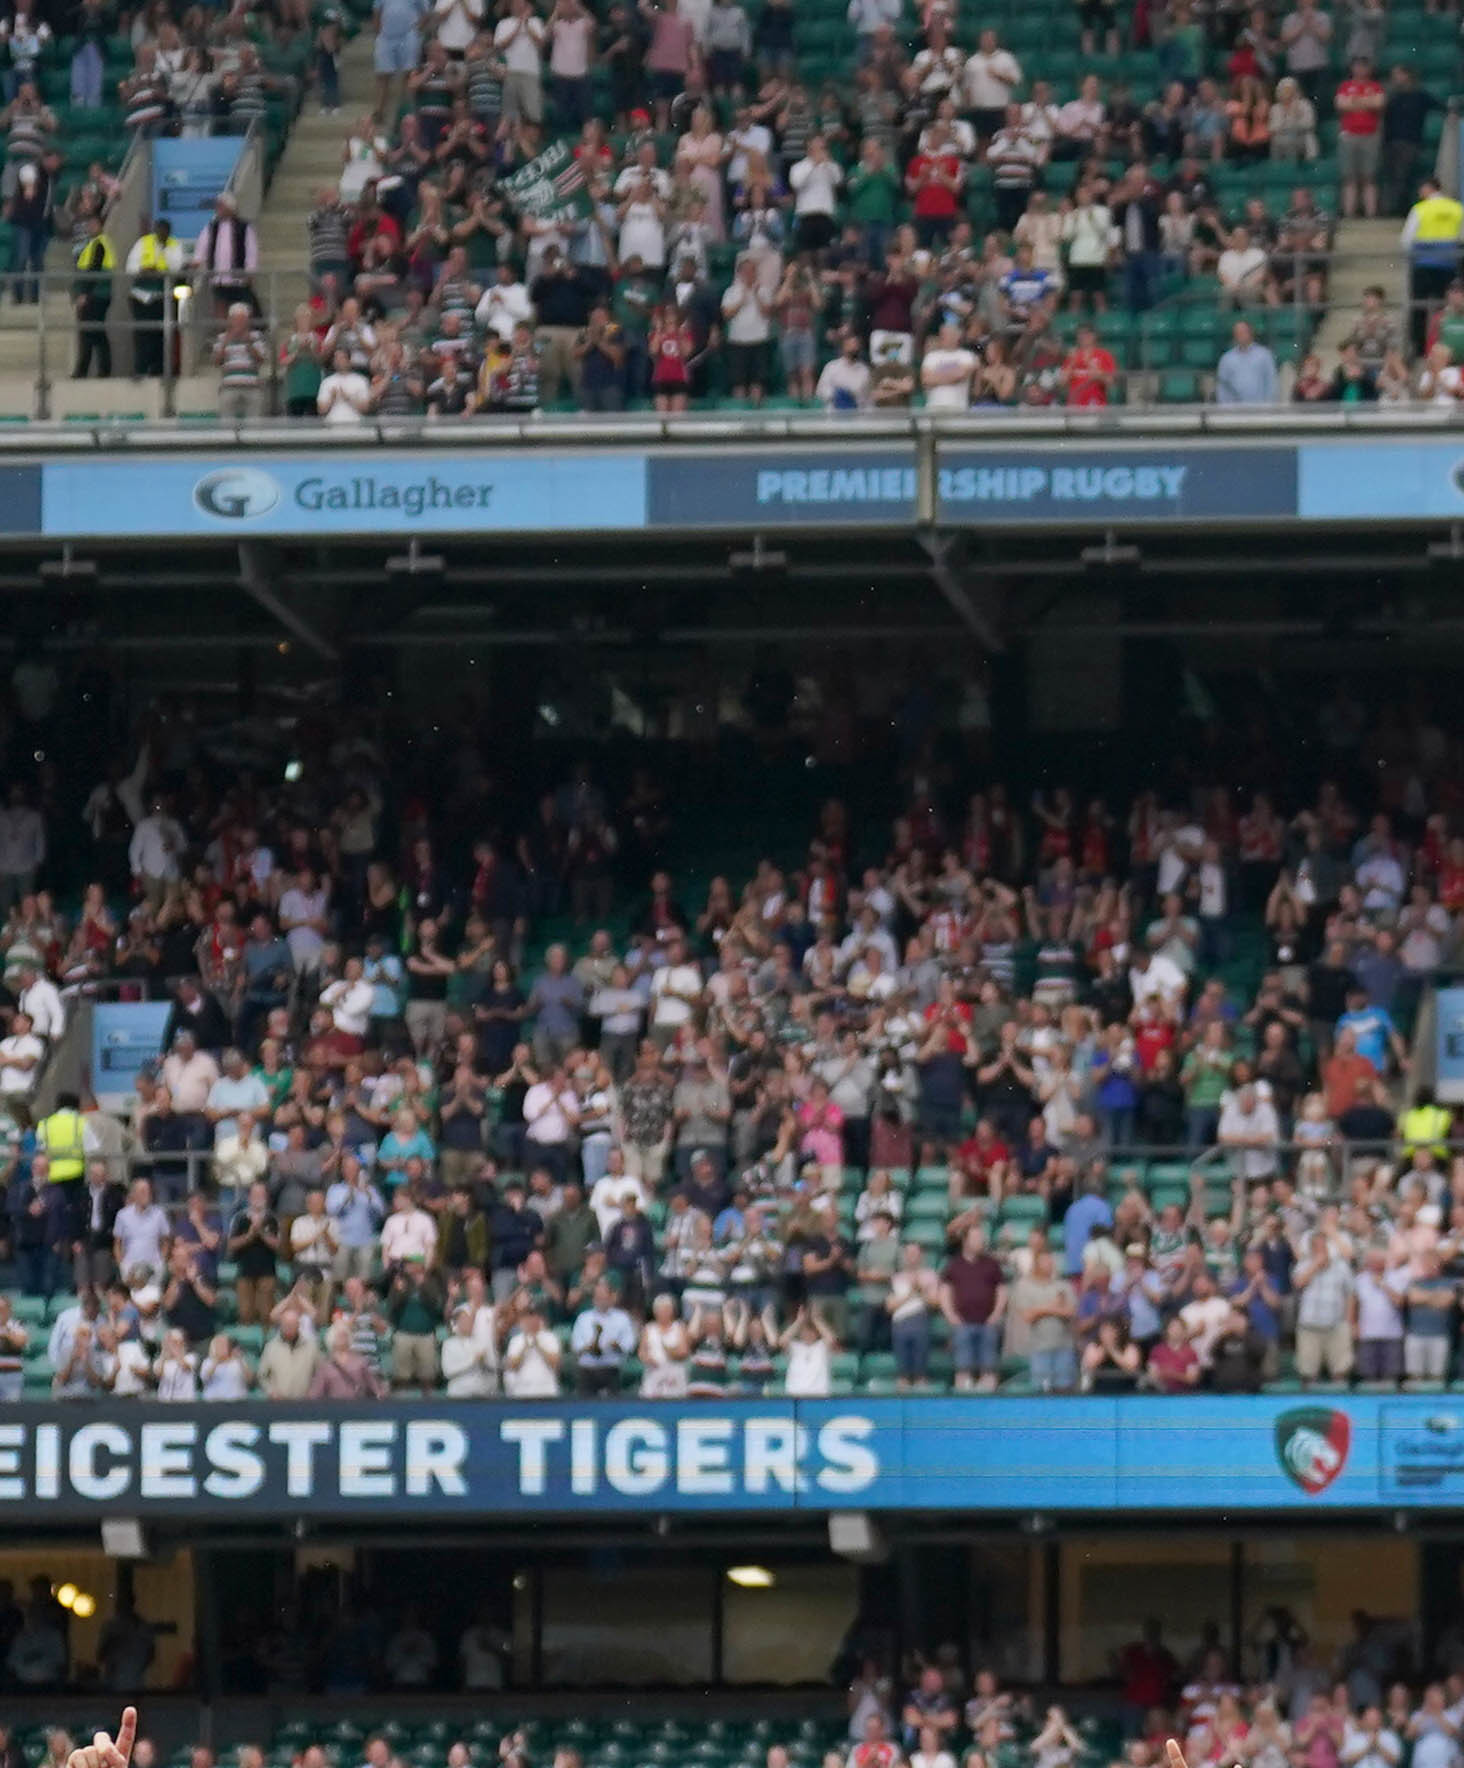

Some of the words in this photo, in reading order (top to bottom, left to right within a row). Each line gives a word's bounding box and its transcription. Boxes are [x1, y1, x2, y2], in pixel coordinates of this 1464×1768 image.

[293, 474, 494, 518] Gallagher
[1050, 465, 1187, 502] RUGBY
[502, 1415, 879, 1495] TIGERS
